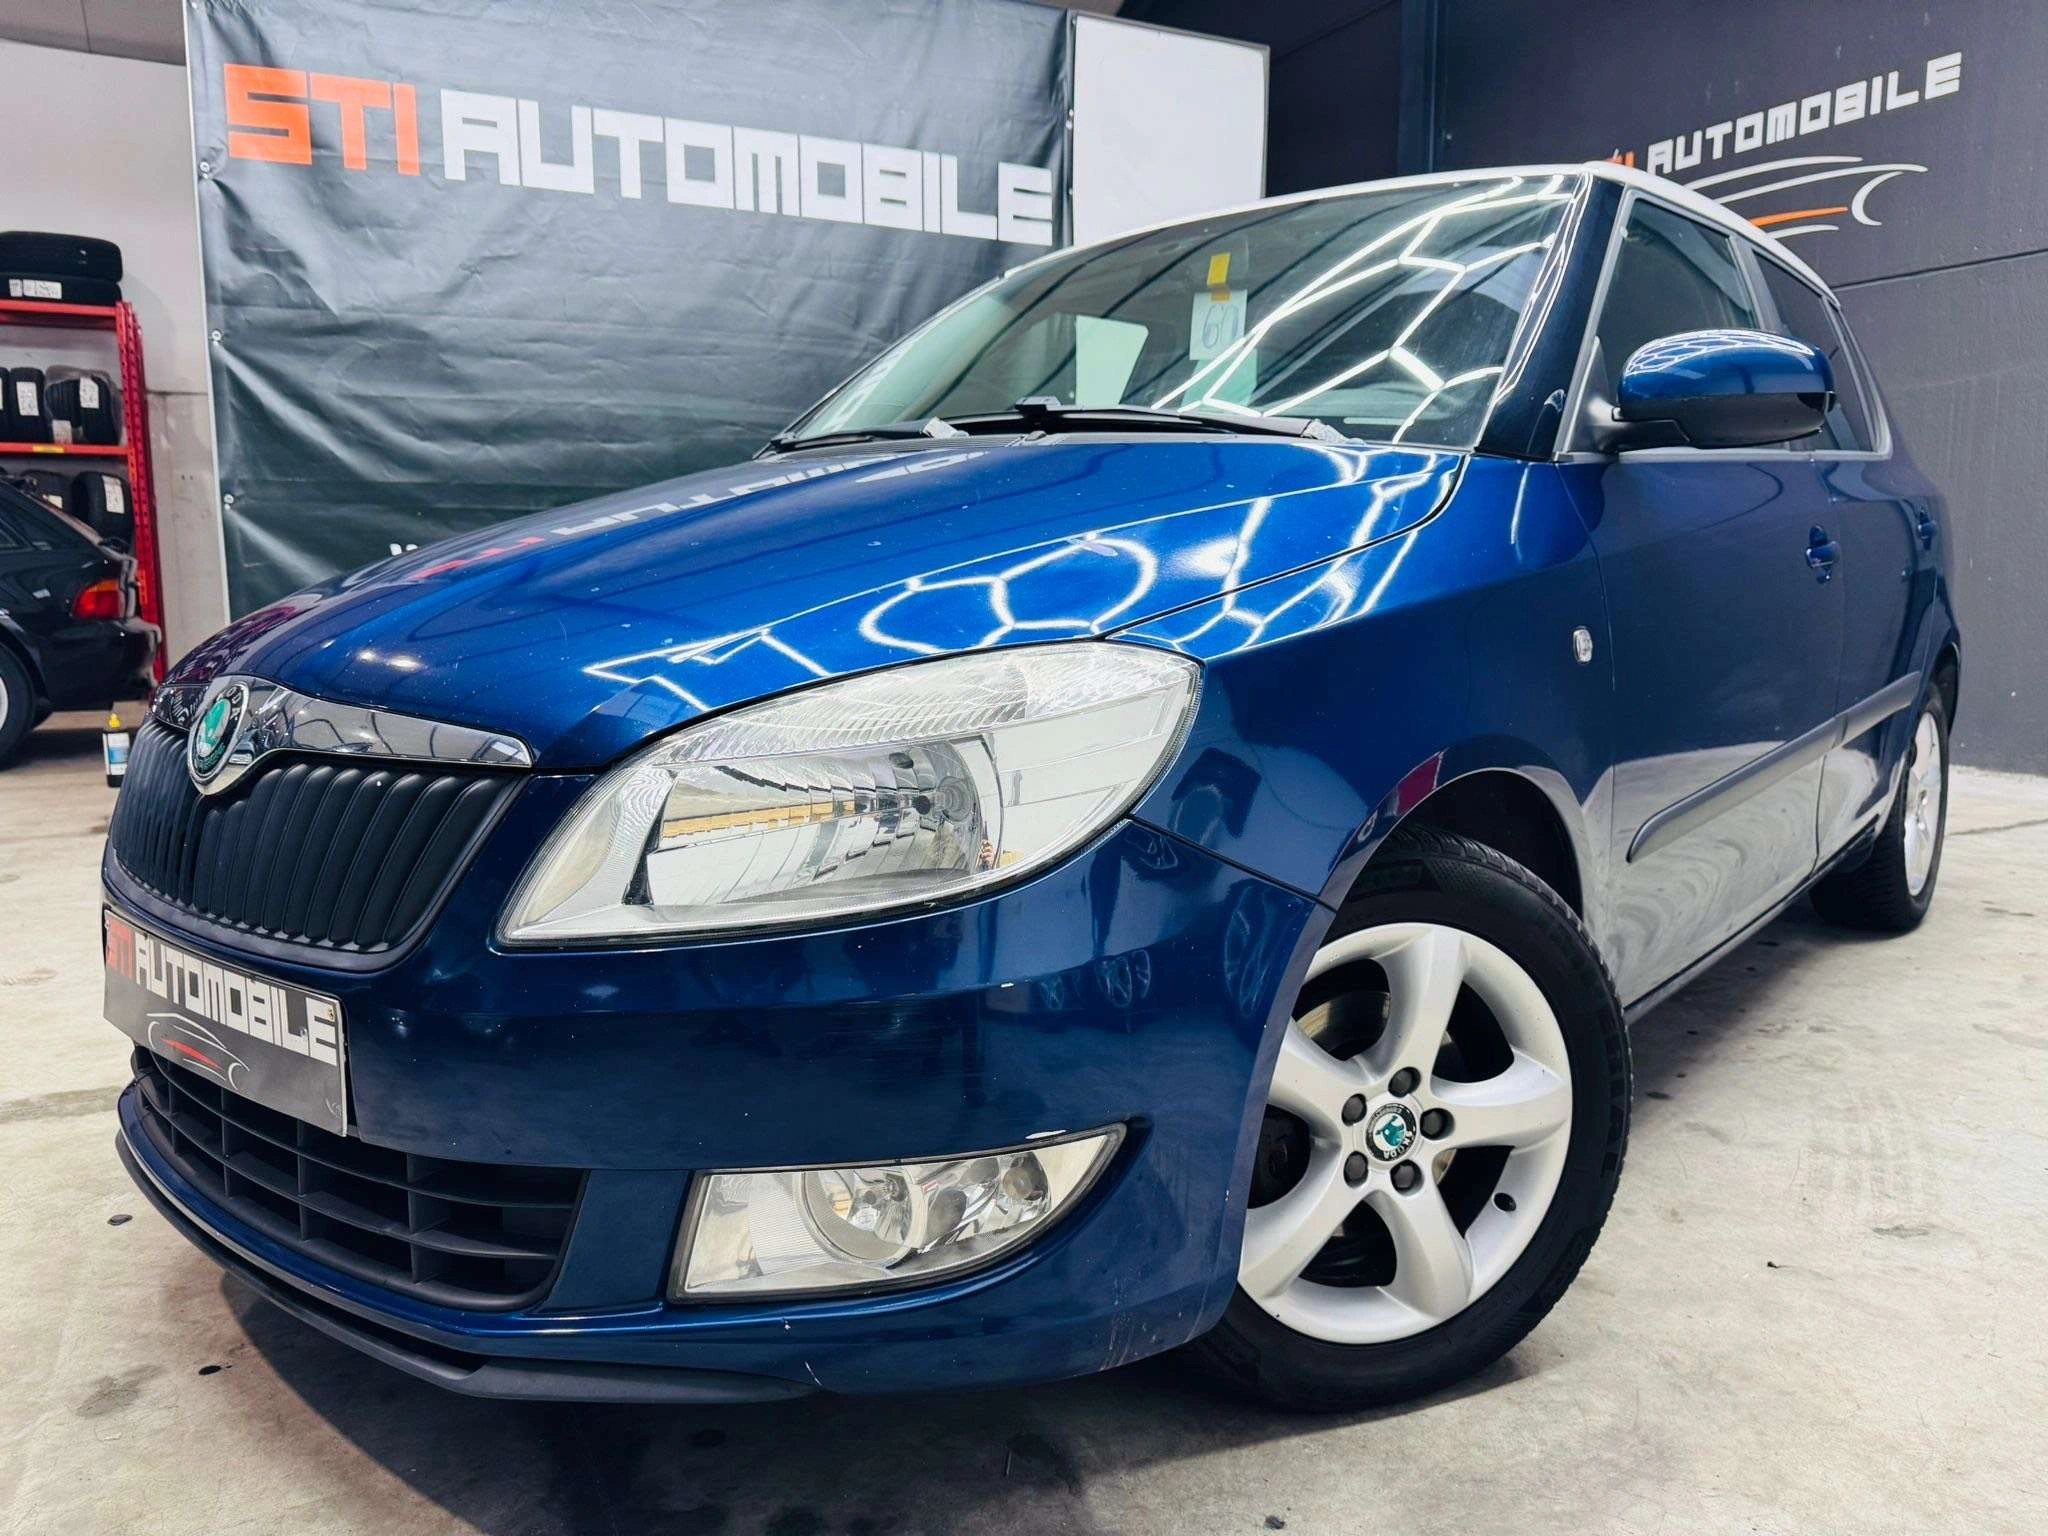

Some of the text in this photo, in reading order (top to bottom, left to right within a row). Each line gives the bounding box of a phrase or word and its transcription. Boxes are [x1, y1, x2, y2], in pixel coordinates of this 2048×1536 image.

[223, 63, 1053, 246] STI AUTOMOBILE
[1646, 51, 1962, 176] AUTOMOBILE
[134, 931, 338, 1067] AUTOMOBILE
